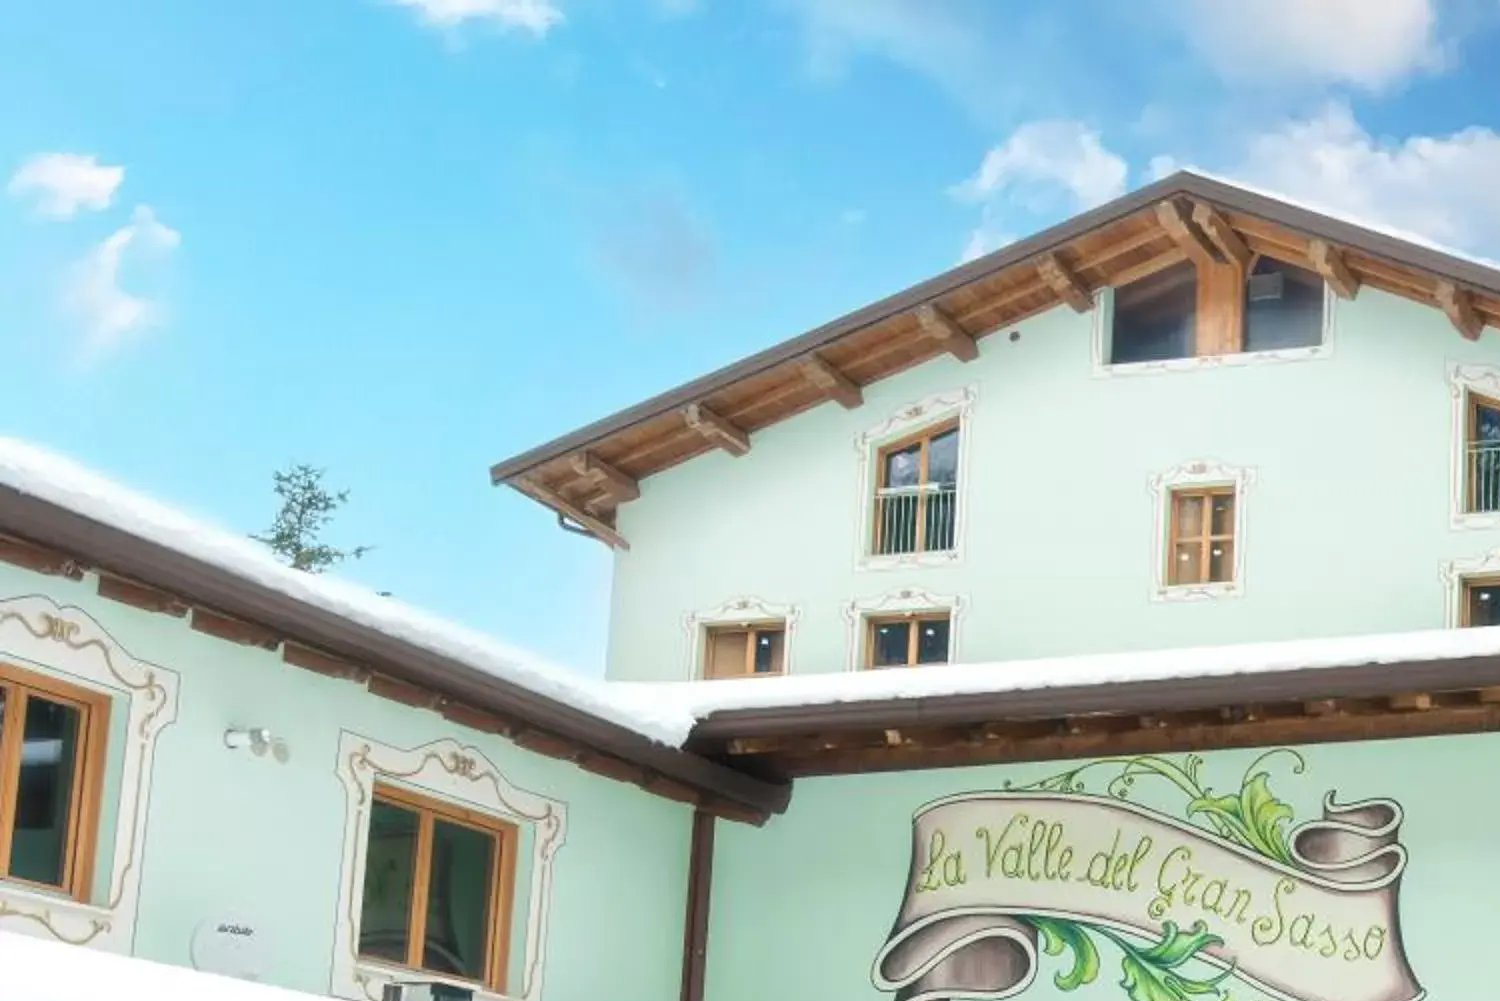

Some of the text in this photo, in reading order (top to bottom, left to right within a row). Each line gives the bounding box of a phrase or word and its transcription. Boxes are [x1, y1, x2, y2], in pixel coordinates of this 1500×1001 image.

[916, 812, 1388, 961] La Valle del Gran Sasso
